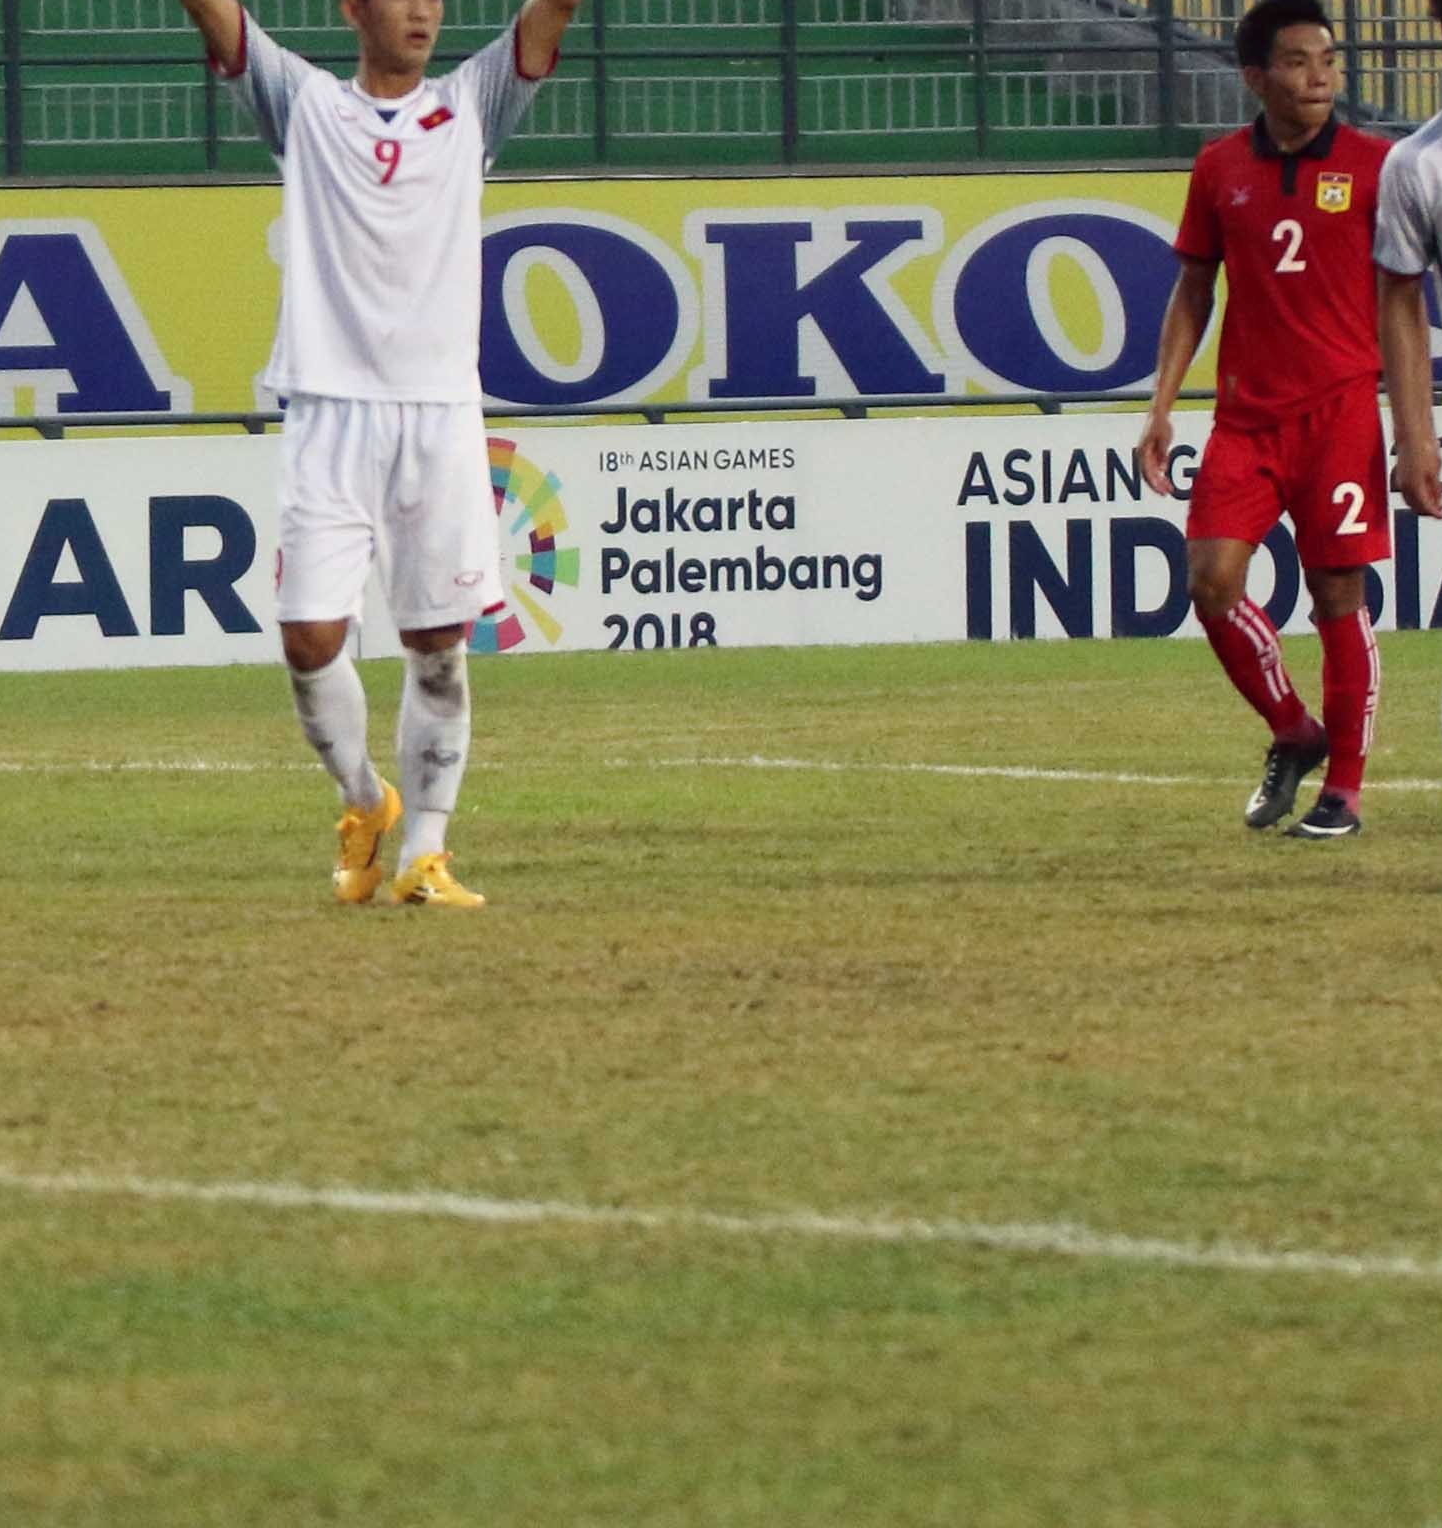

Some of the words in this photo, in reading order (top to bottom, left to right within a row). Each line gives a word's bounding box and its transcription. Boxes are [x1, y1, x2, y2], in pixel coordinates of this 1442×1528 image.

[374, 139, 402, 186] 9
[1271, 218, 1307, 273] 2
[277, 213, 1180, 411] OKO
[599, 449, 635, 472] 18th
[639, 448, 709, 471] ASIAN
[713, 447, 796, 470] GAMES
[957, 447, 1143, 506] ASIAN
[599, 487, 796, 534] Jakarta
[1331, 481, 1369, 536] 2
[600, 545, 883, 601] Palembang
[601, 611, 719, 651] 2018
